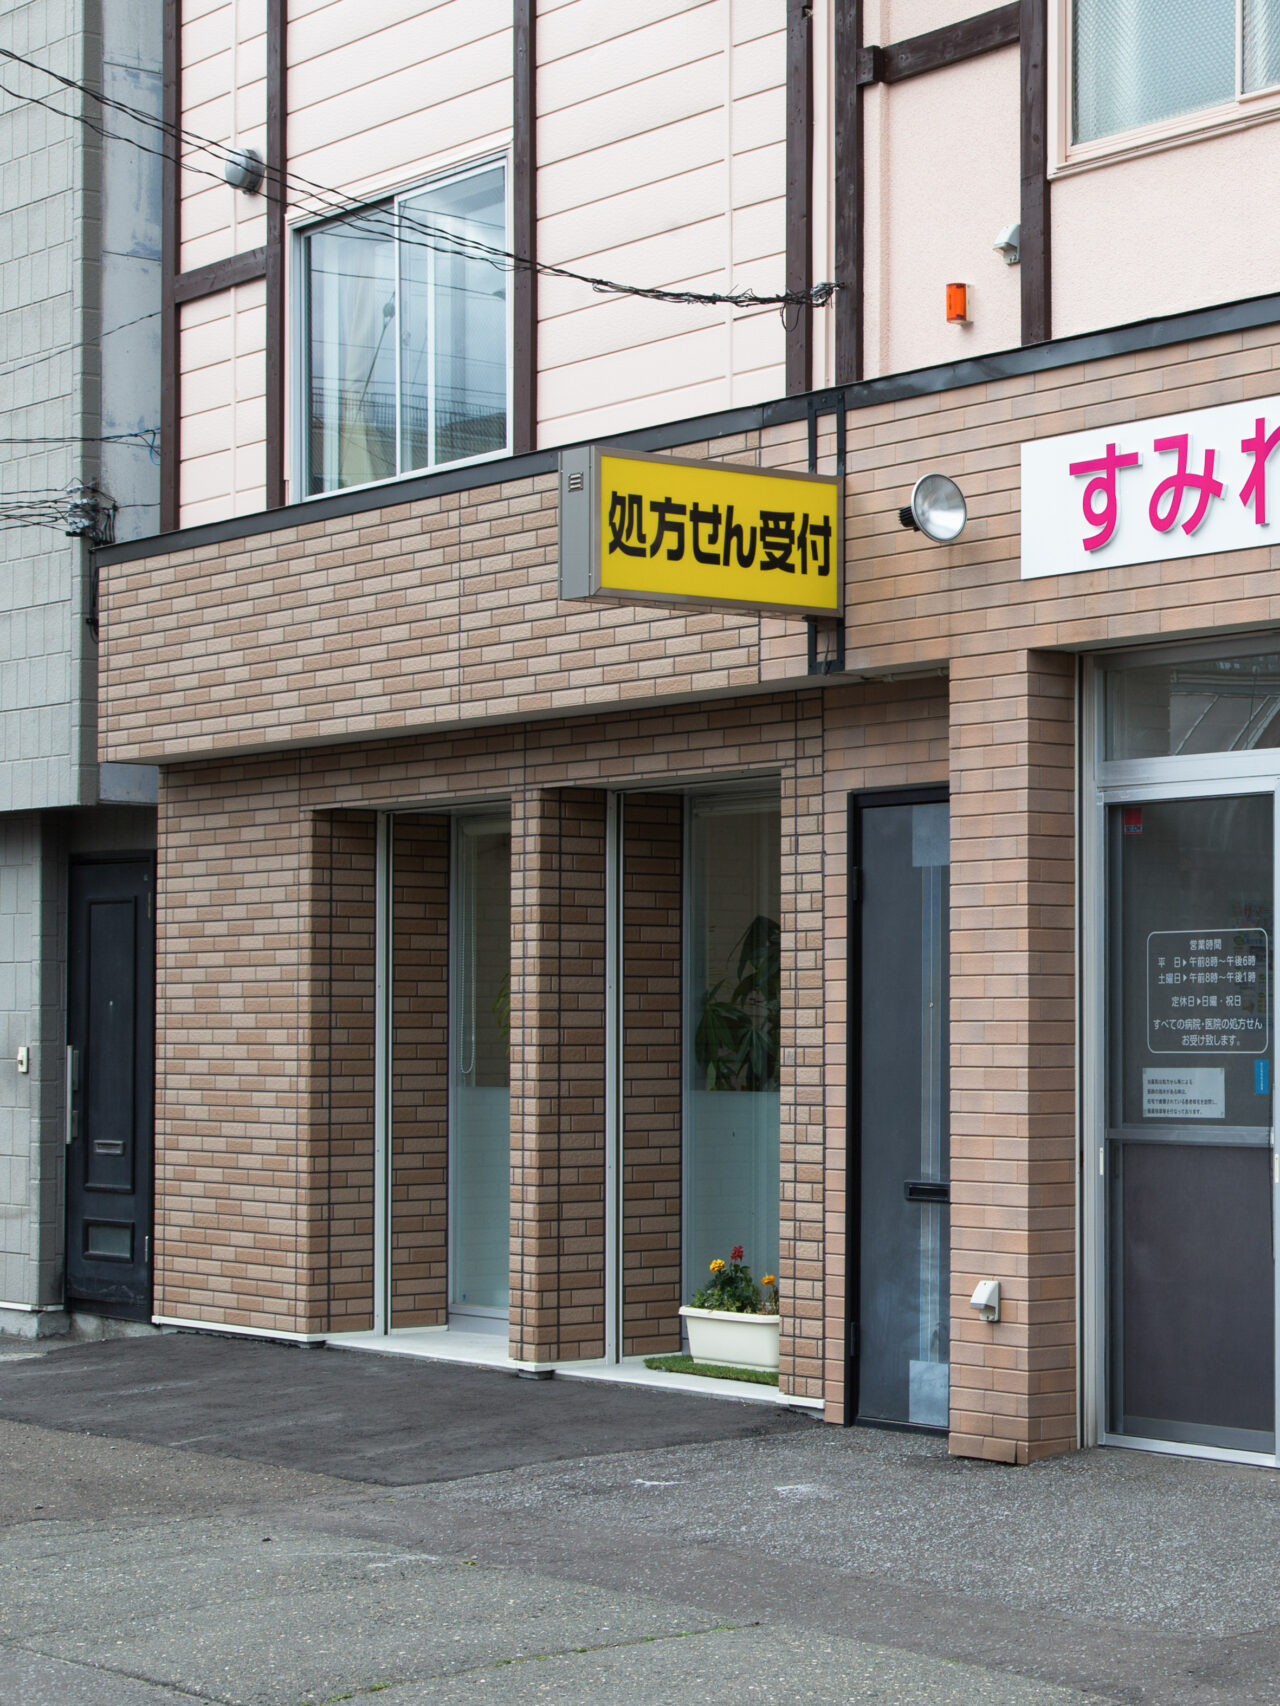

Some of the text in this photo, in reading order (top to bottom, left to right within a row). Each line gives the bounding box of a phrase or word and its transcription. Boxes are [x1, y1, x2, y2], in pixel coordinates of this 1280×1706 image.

[609, 491, 832, 576] 処方せん受付
[1189, 938, 1222, 951] 営業時間
